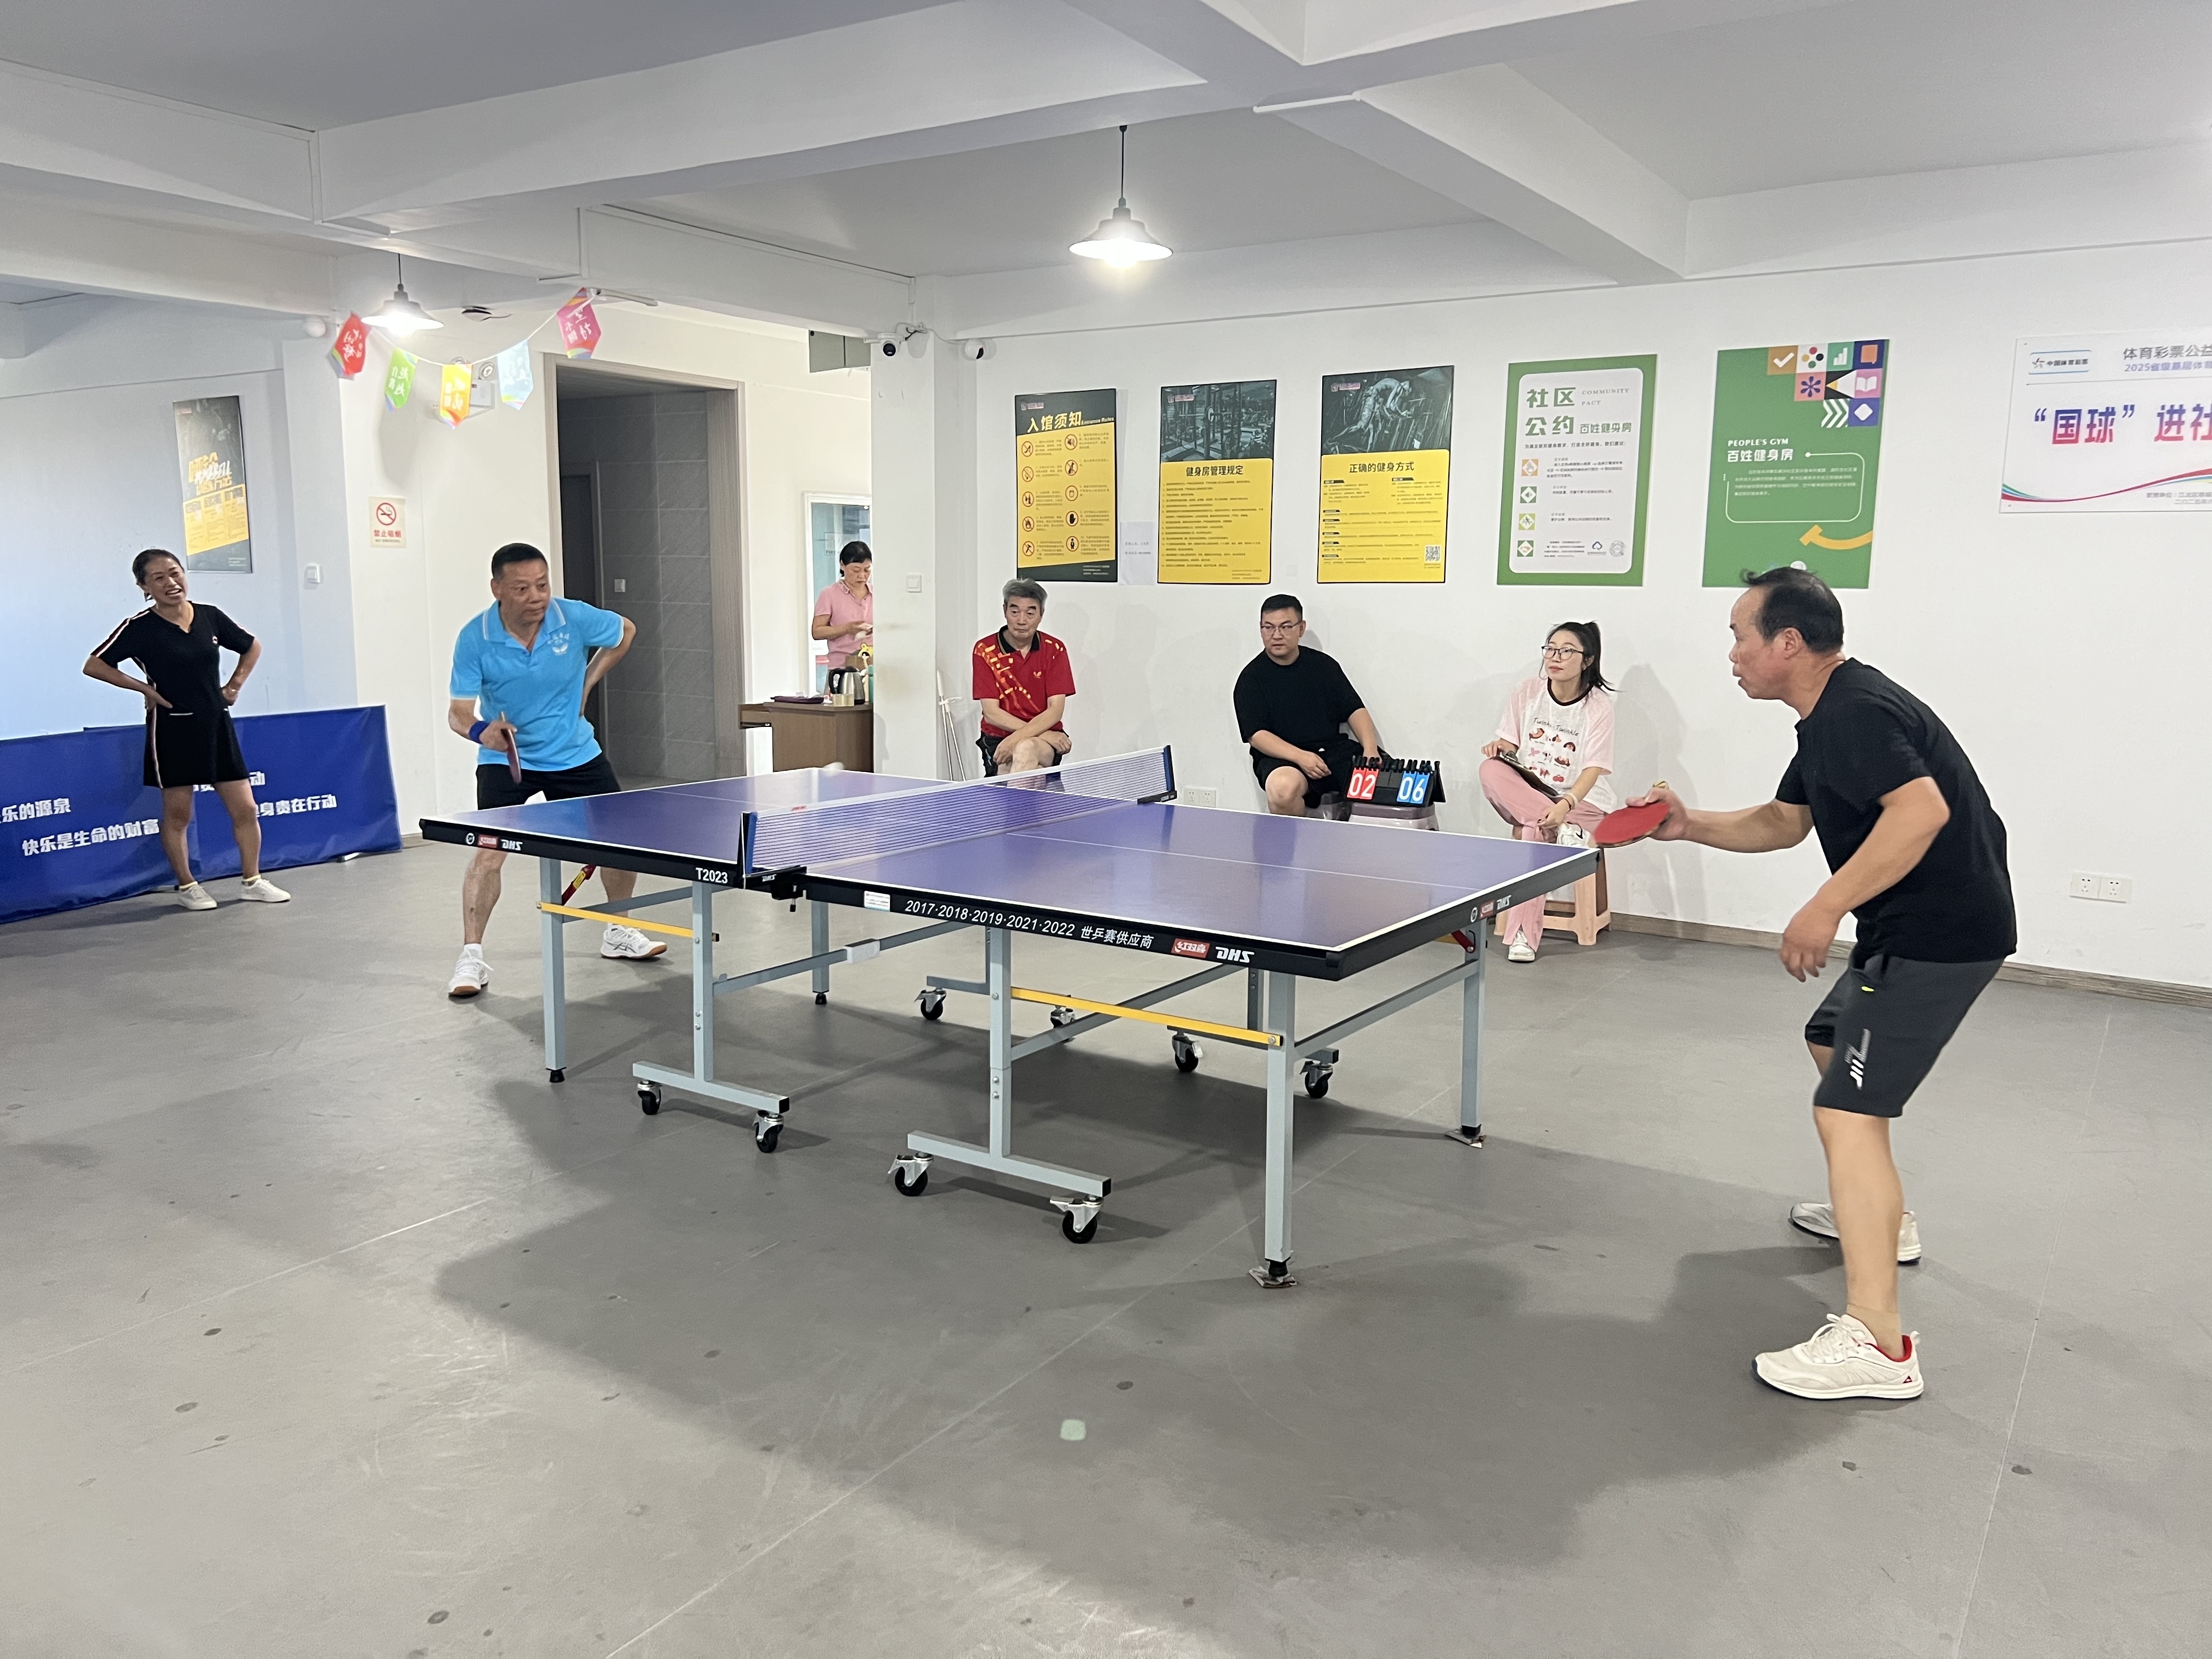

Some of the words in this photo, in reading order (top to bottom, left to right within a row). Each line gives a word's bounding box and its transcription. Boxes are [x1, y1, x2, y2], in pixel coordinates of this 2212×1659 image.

[1527, 387, 1576, 408] 社区
[1027, 411, 1082, 433] 入馆须知
[1525, 415, 1574, 436] 公约
[1580, 422, 1632, 434] 百姓健身房
[1728, 449, 1793, 462] 百姓健身房
[1186, 466, 1243, 476] 健身房管理规定
[1349, 461, 1414, 473] 正确的健身方式
[1556, 725, 1579, 736] Twinkle
[1349, 773, 1376, 797] 02
[1399, 777, 1425, 802] 06
[0, 798, 71, 823] 乐的源泉
[22, 819, 160, 856] 快乐是生命的财富
[696, 867, 728, 884] T2023
[1081, 926, 1154, 950] 世乒赛供应商
[1215, 941, 1255, 963] DHS
